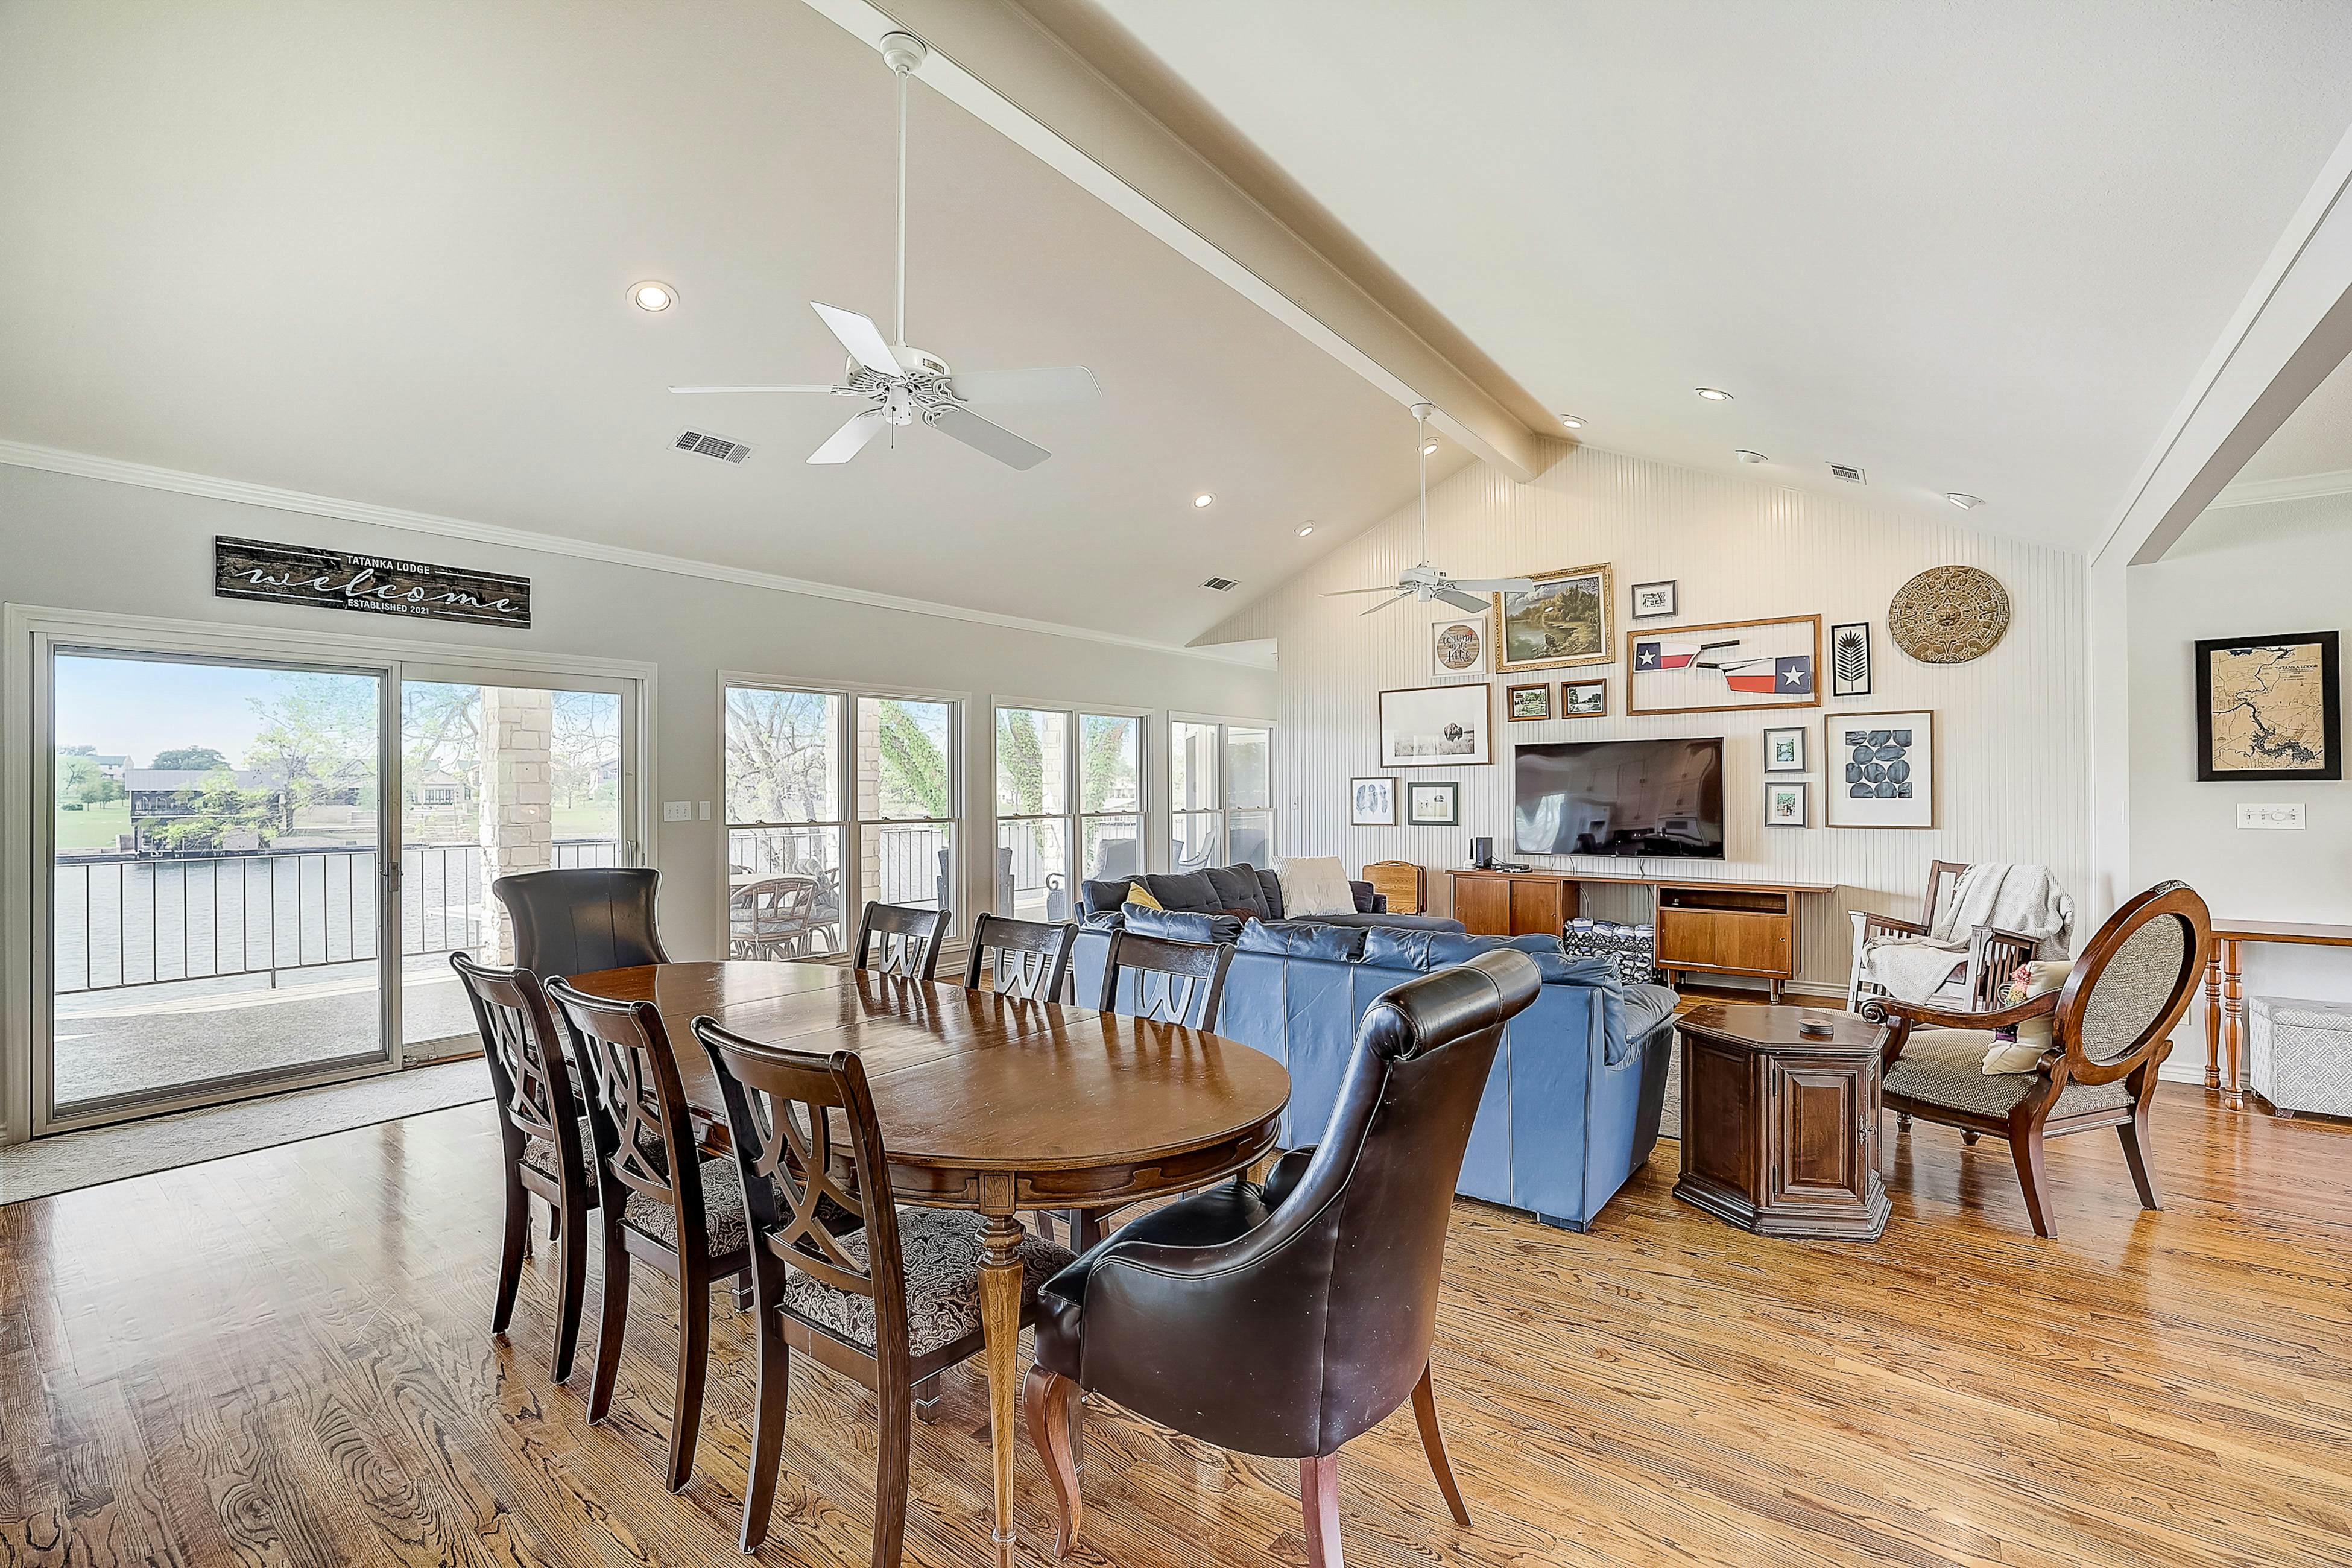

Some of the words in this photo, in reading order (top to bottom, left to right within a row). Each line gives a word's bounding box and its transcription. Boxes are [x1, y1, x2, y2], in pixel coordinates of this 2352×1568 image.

[346, 555, 393, 570] TATANKA
[397, 562, 430, 575] LODGE
[235, 568, 519, 613] welcome
[347, 599, 408, 612] ESTABLISHED
[410, 605, 429, 615] 2021
